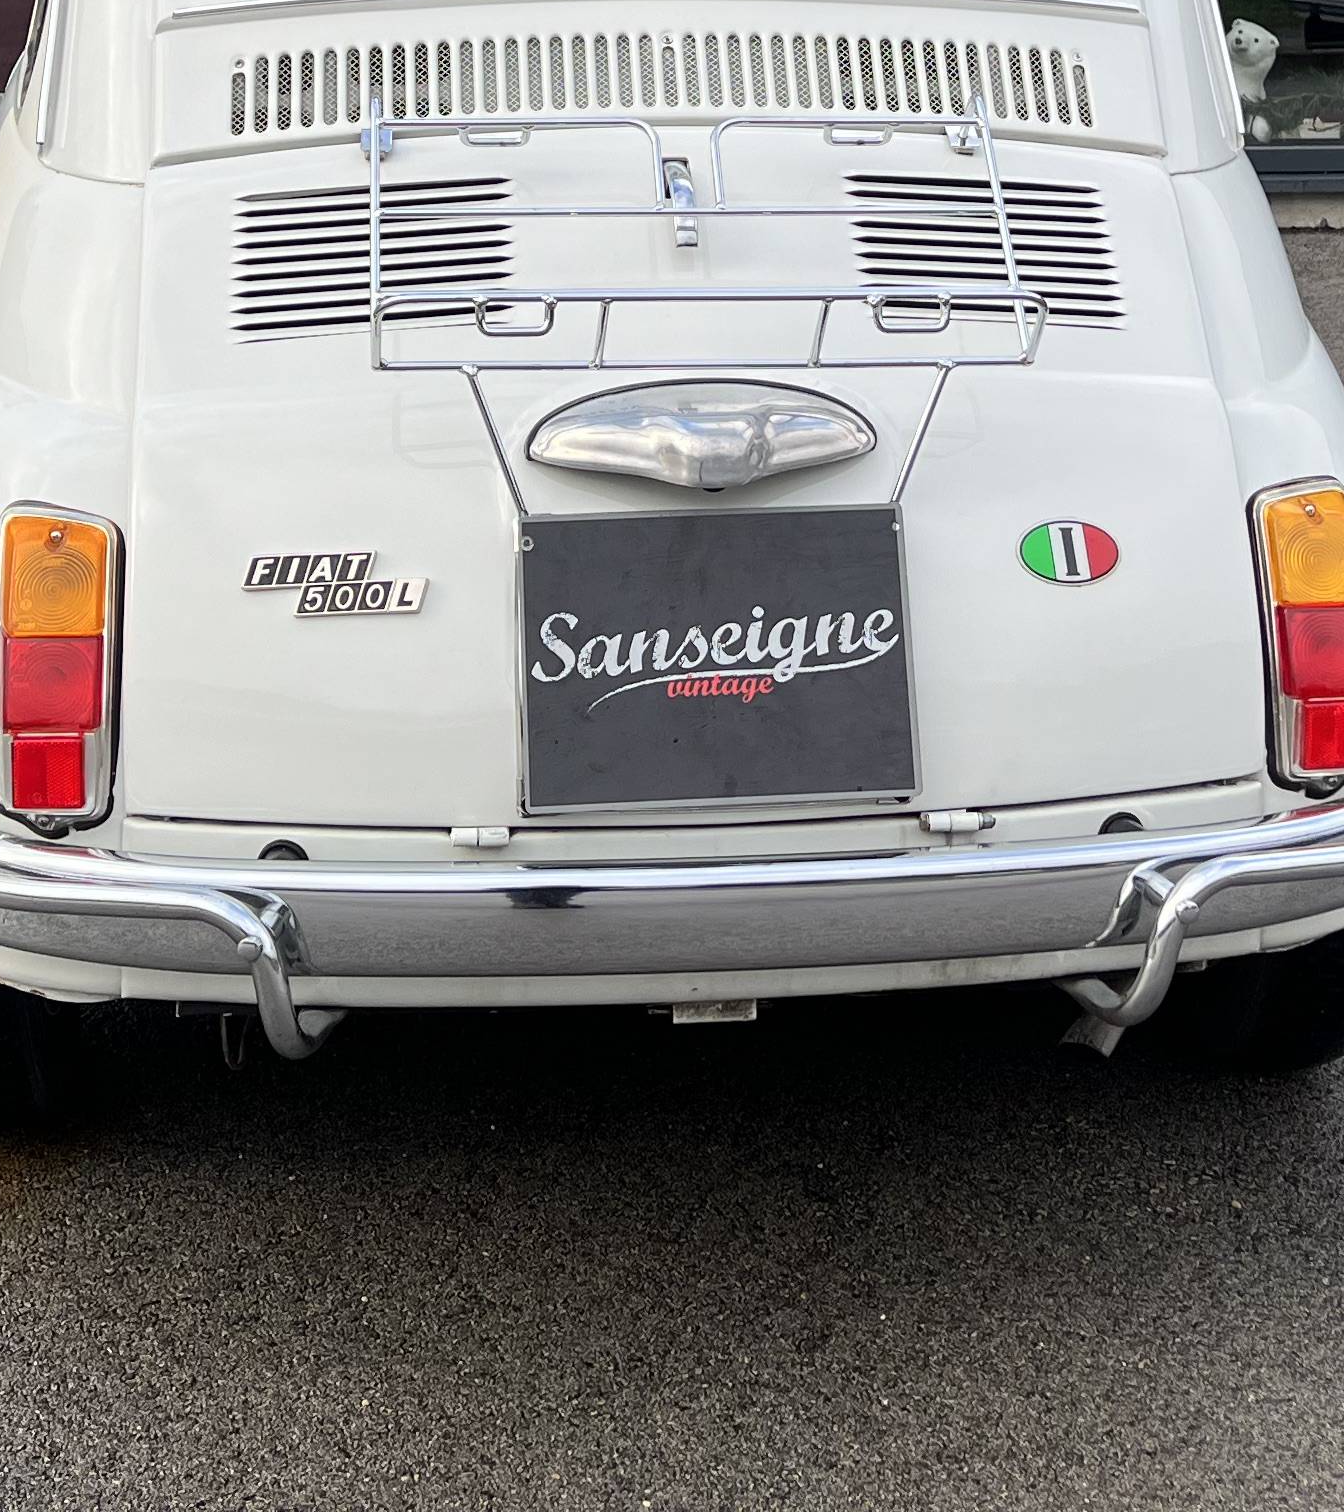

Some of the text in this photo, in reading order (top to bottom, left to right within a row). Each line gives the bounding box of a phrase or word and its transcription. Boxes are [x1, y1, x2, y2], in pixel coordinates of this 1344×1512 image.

[247, 553, 369, 585] FIAT
[1058, 527, 1081, 576] I
[530, 605, 900, 684] Sanseigne
[666, 673, 776, 704] vintage
